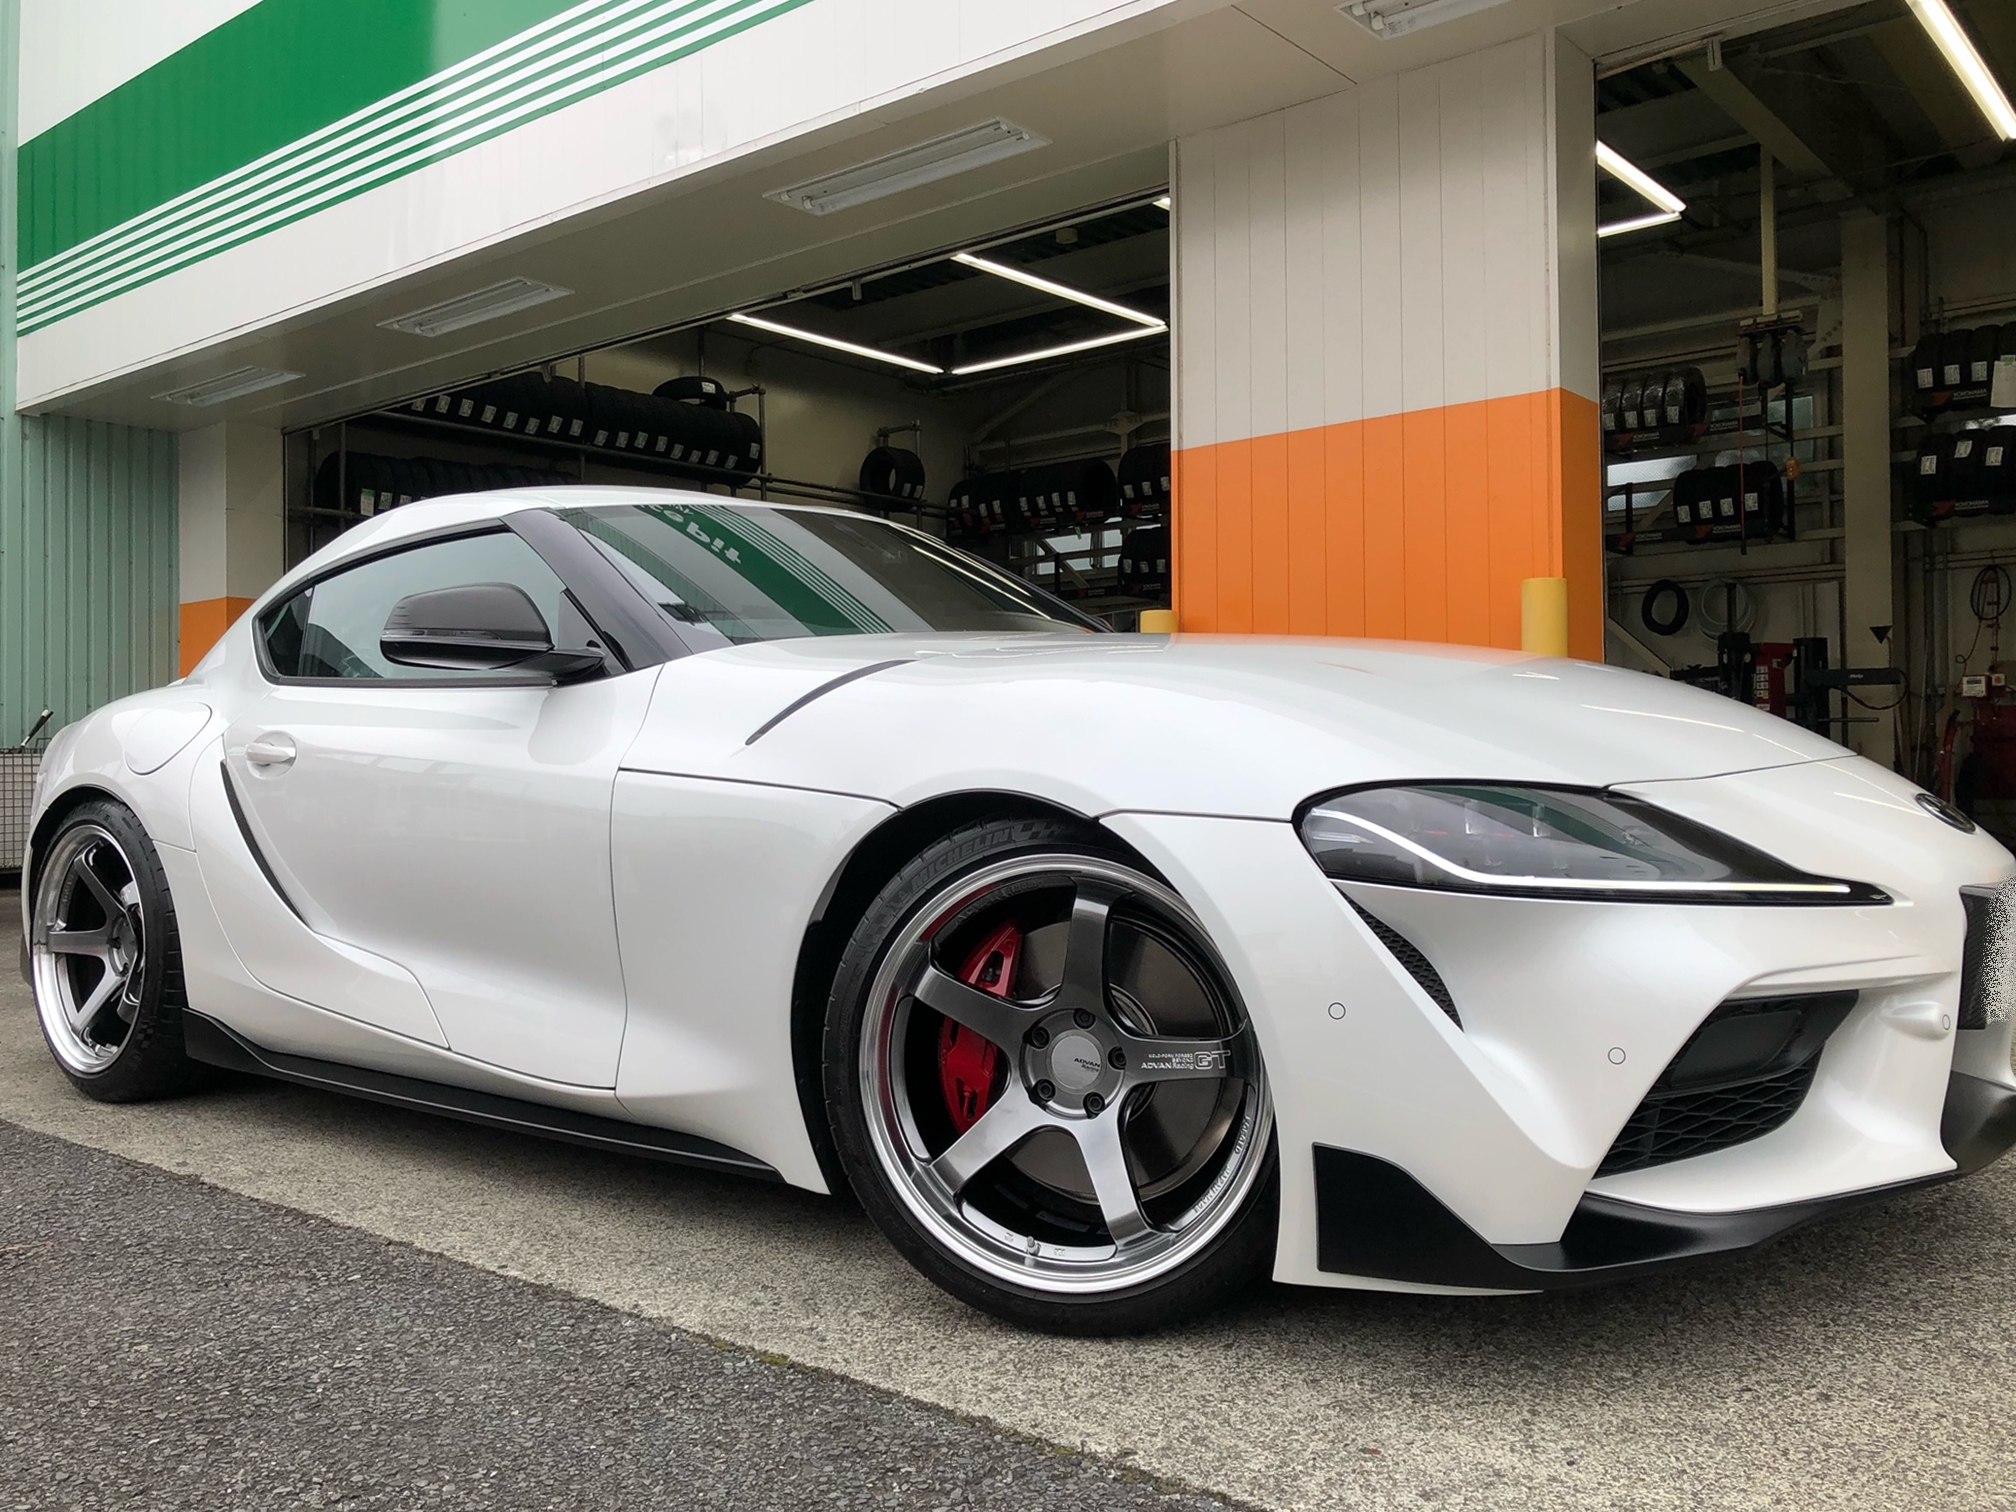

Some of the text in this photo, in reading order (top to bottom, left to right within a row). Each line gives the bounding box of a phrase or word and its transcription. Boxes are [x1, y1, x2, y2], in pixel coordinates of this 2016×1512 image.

[910, 828, 1010, 891] MICHELIN
[1074, 1057, 1101, 1068] ADVAN
[1141, 1050, 1231, 1070] ADVAN Racing GT
